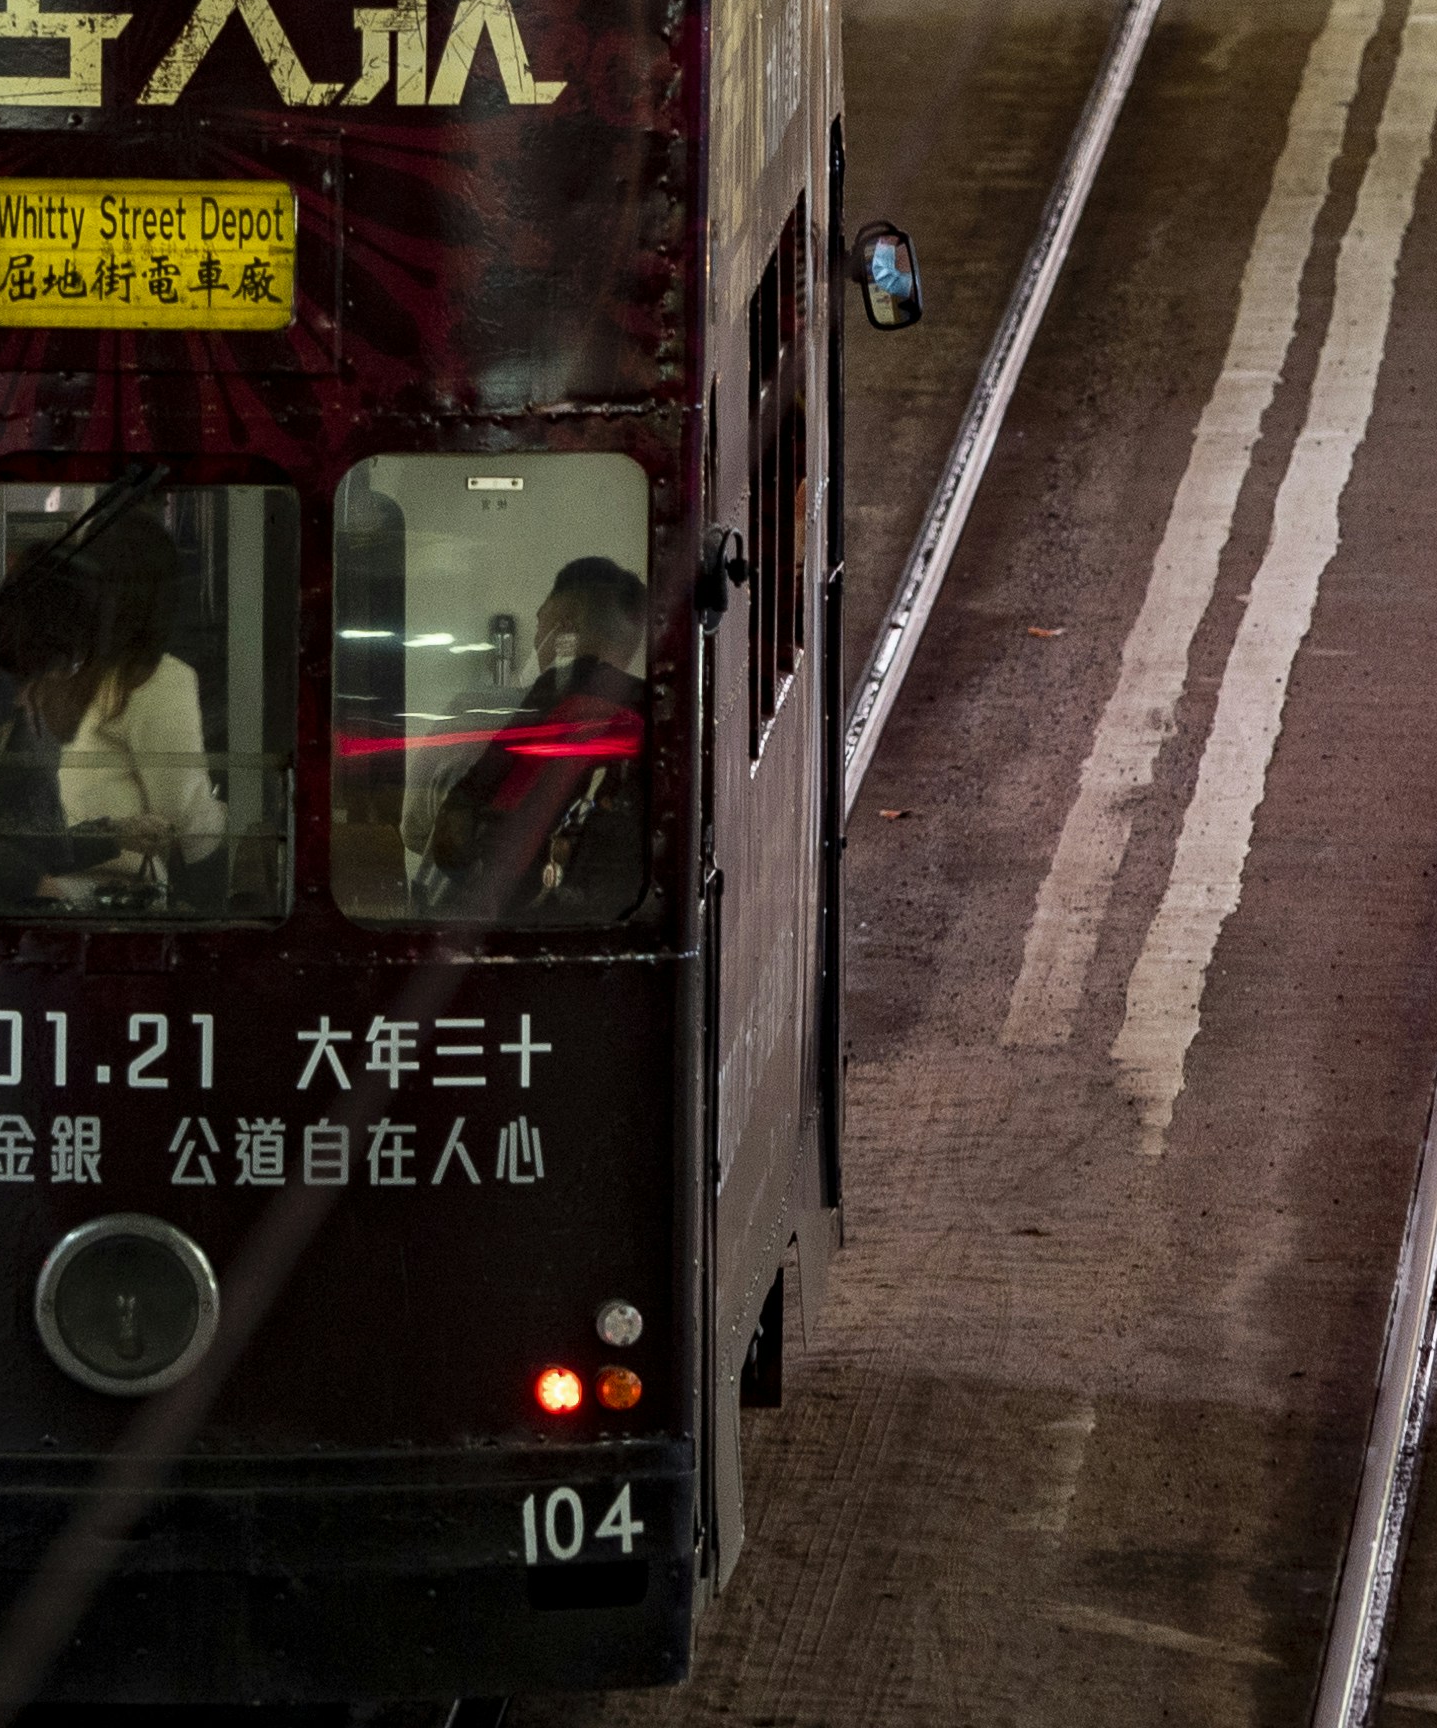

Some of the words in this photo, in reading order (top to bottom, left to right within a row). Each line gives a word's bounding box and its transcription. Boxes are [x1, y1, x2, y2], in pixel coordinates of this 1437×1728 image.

[99, 194, 186, 242] Street
[200, 196, 284, 250] Depot
[296, 1013, 552, 1090] 大年三十
[168, 1115, 545, 1186] 公道自在人心
[520, 1484, 645, 1564] 104
